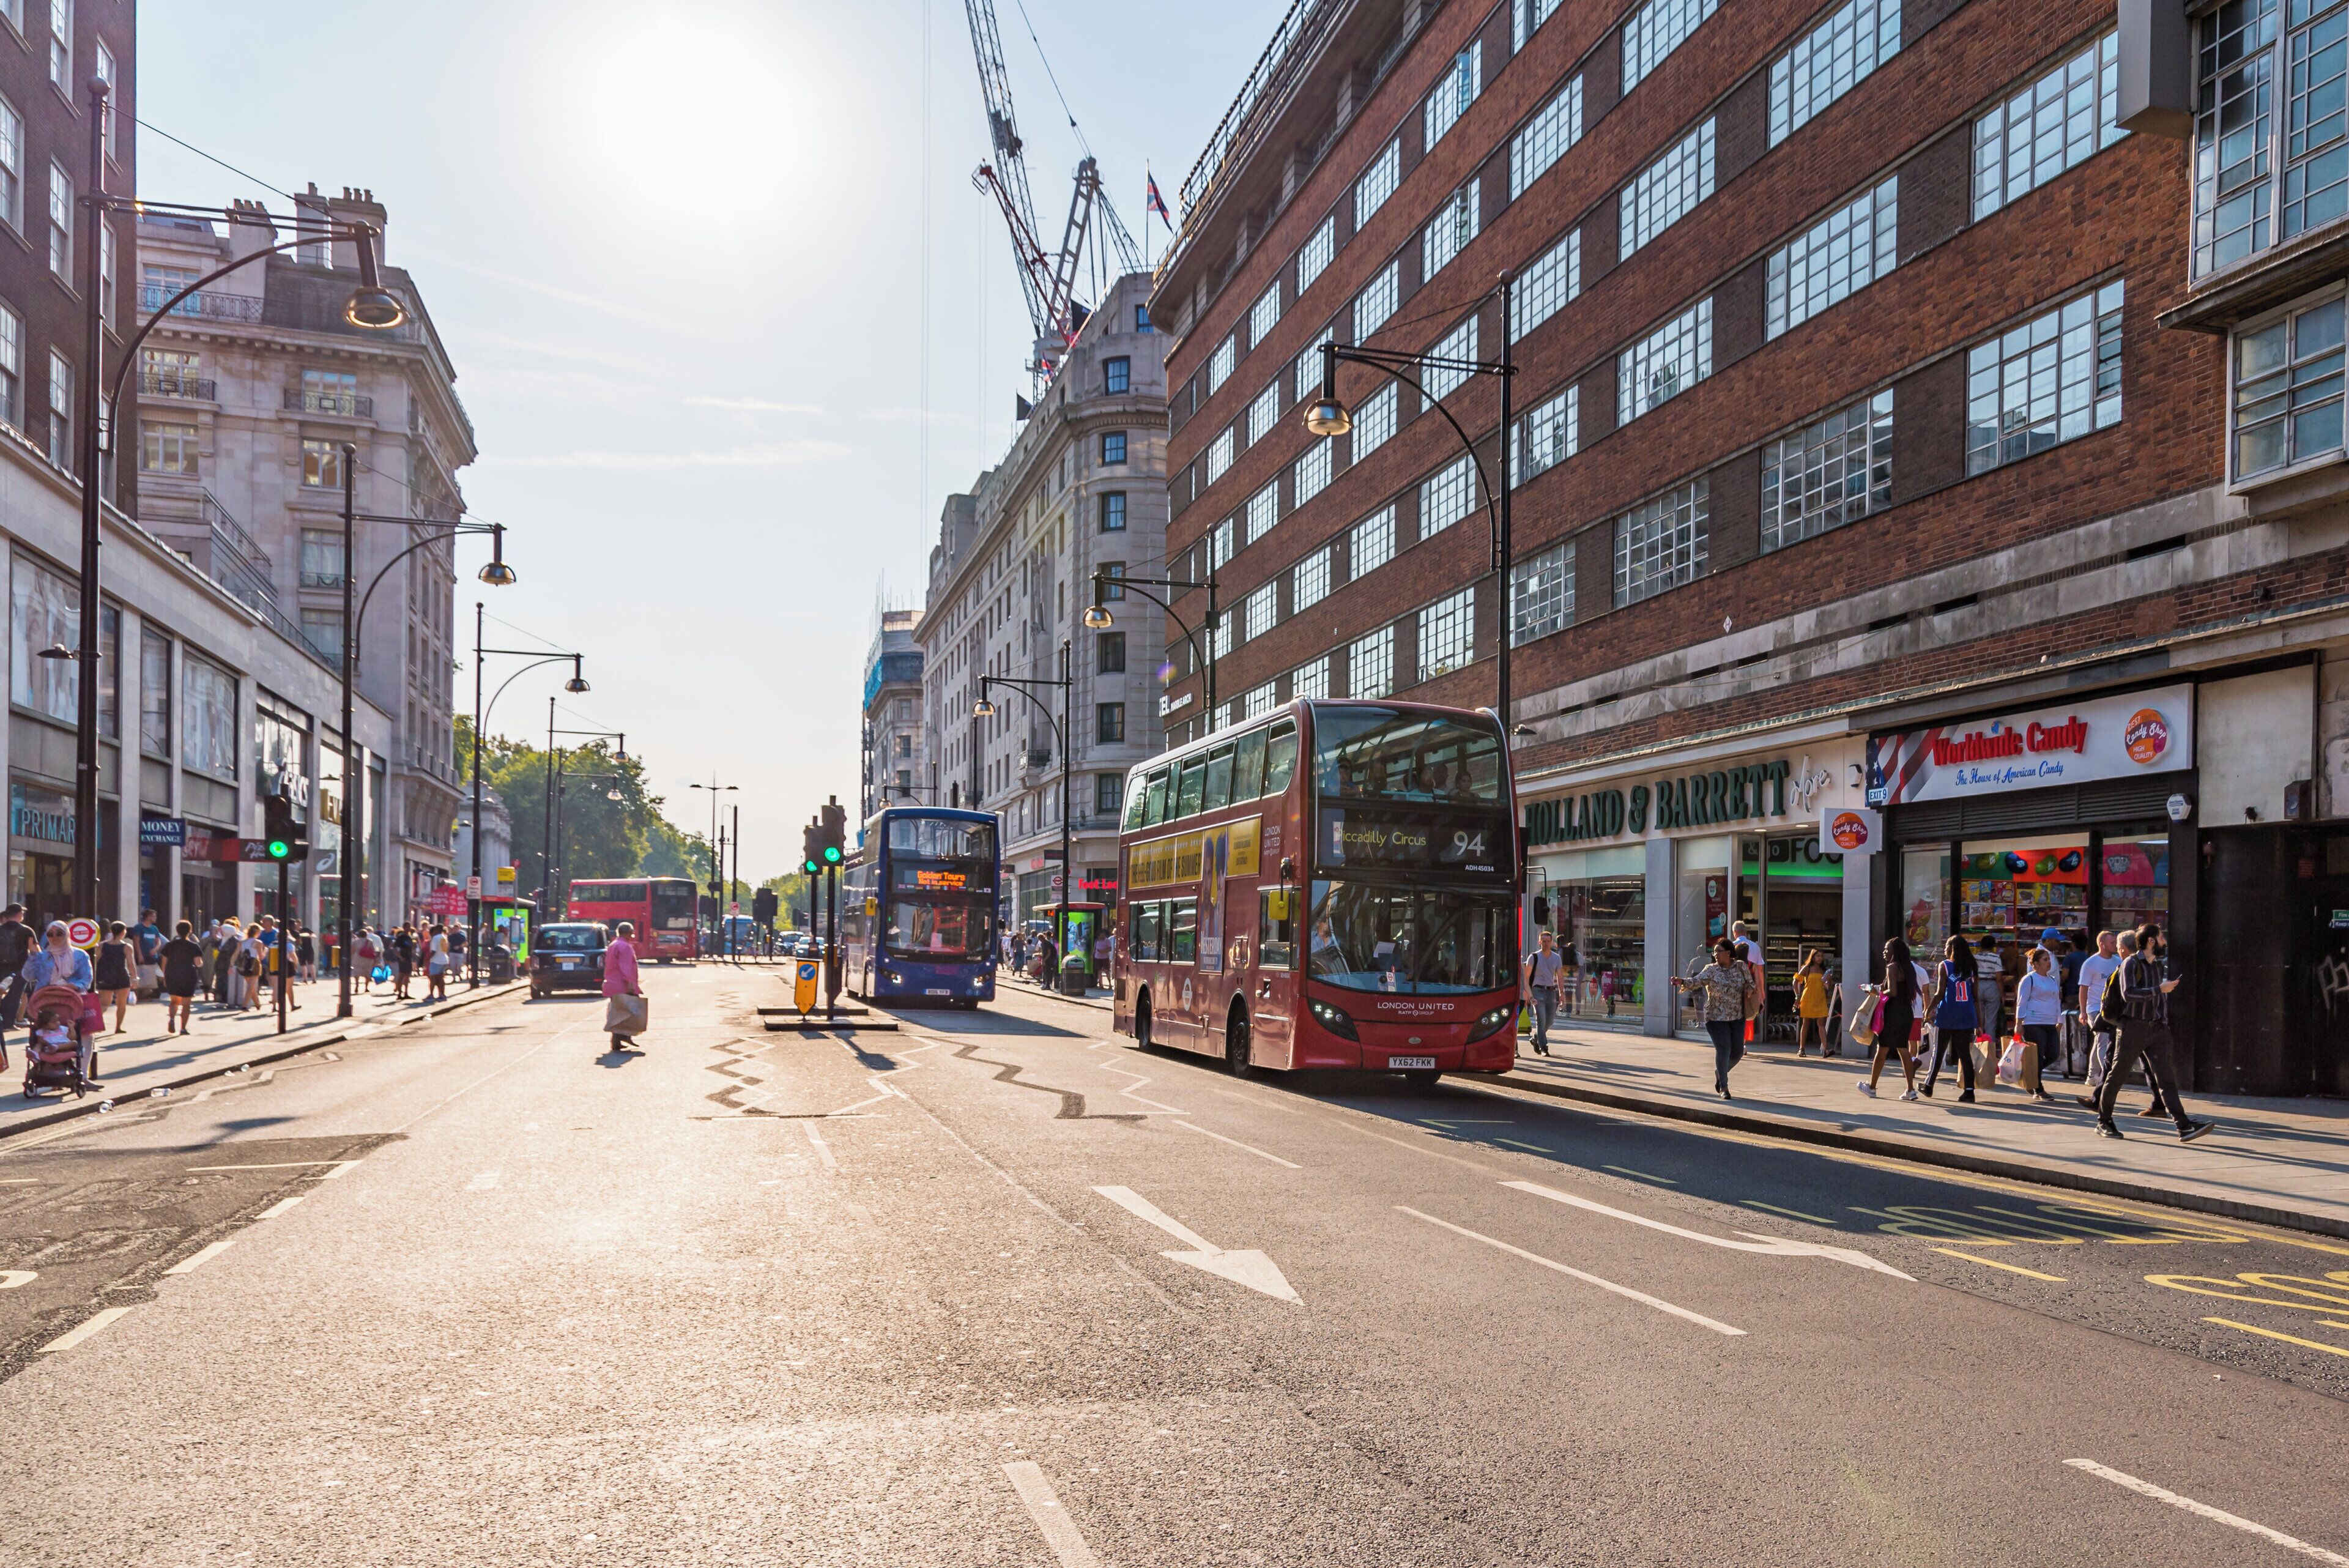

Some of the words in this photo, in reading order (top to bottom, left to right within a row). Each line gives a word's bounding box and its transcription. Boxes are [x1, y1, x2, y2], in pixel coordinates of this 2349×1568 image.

[2127, 716, 2141, 732] BEST
[1932, 726, 2023, 766] Worldwide
[2027, 715, 2088, 754] Candy
[2126, 724, 2147, 745] Candy
[2149, 723, 2166, 738] Shop
[2134, 751, 2153, 760] QUALITY
[1955, 770, 1967, 786] The
[1970, 767, 1992, 784] House
[1993, 770, 2002, 784] of
[2002, 767, 2036, 784] American
[2038, 760, 2064, 778] Candy
[1869, 790, 1882, 800] EXIT
[1882, 788, 1888, 800] 9
[1524, 789, 1625, 847] HOLLAND
[1628, 785, 1650, 834] &
[1654, 759, 1790, 831] BARRETT
[21, 808, 76, 844] PRIMAR
[141, 821, 182, 833] MONEY
[1264, 825, 1281, 836] LONDON
[1833, 823, 1850, 836] Candy
[1852, 823, 1867, 835] Shop
[141, 834, 182, 844] EXCHANGE
[1264, 837, 1280, 849] UNITED
[1392, 831, 1427, 846] Circus
[1453, 831, 1485, 857] 94
[917, 871, 942, 880] Golden
[943, 872, 966, 881] Tours
[1078, 877, 1100, 890] Foot
[1102, 877, 1118, 890] Loc
[1955, 981, 1969, 1002] 11
[1392, 1058, 1414, 1066] YX62
